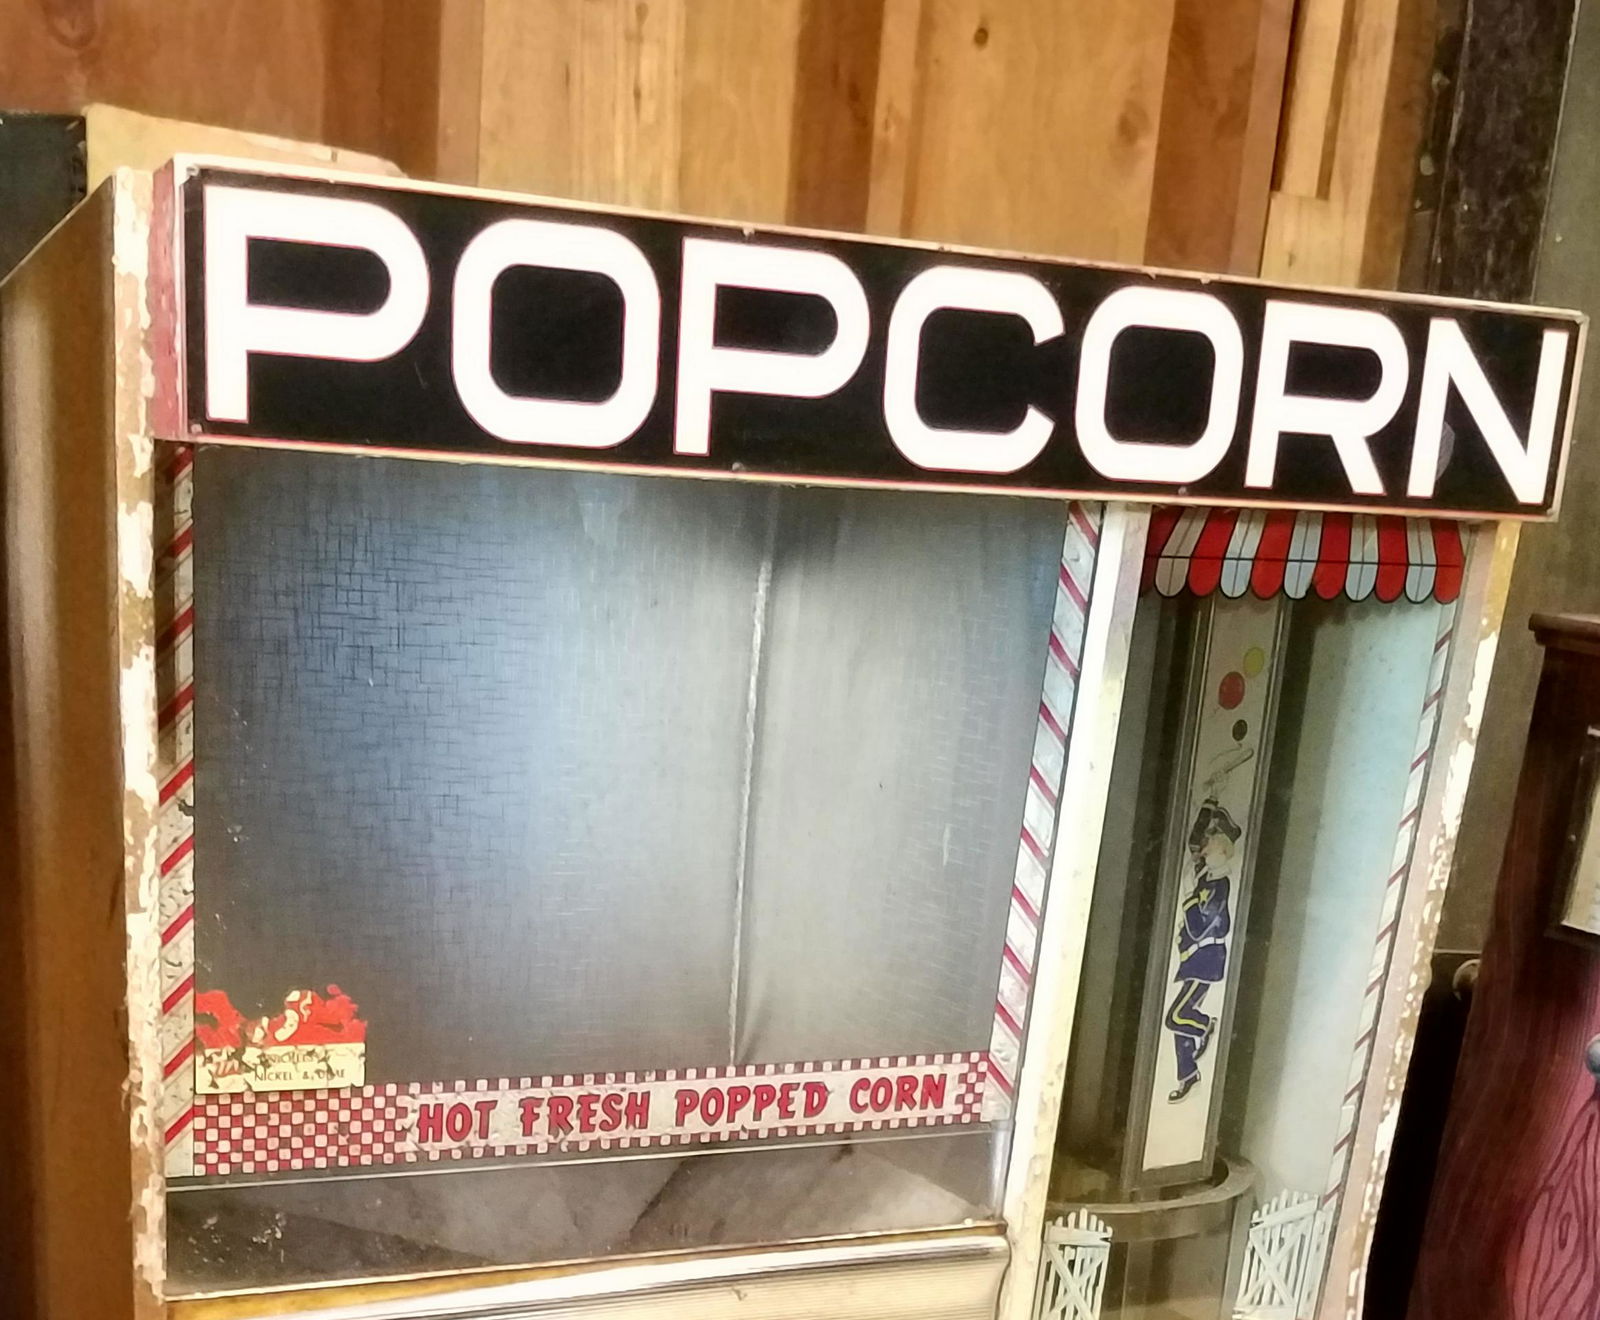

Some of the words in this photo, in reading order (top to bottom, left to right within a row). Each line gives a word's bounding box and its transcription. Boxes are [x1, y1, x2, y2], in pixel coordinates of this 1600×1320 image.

[203, 184, 1569, 506] POPCORN
[254, 1067, 294, 1082] NICKEL
[416, 1099, 499, 1145] HOT
[518, 1090, 652, 1139] FRESH
[674, 1080, 831, 1127] POPPED
[848, 1073, 949, 1114] CORN
